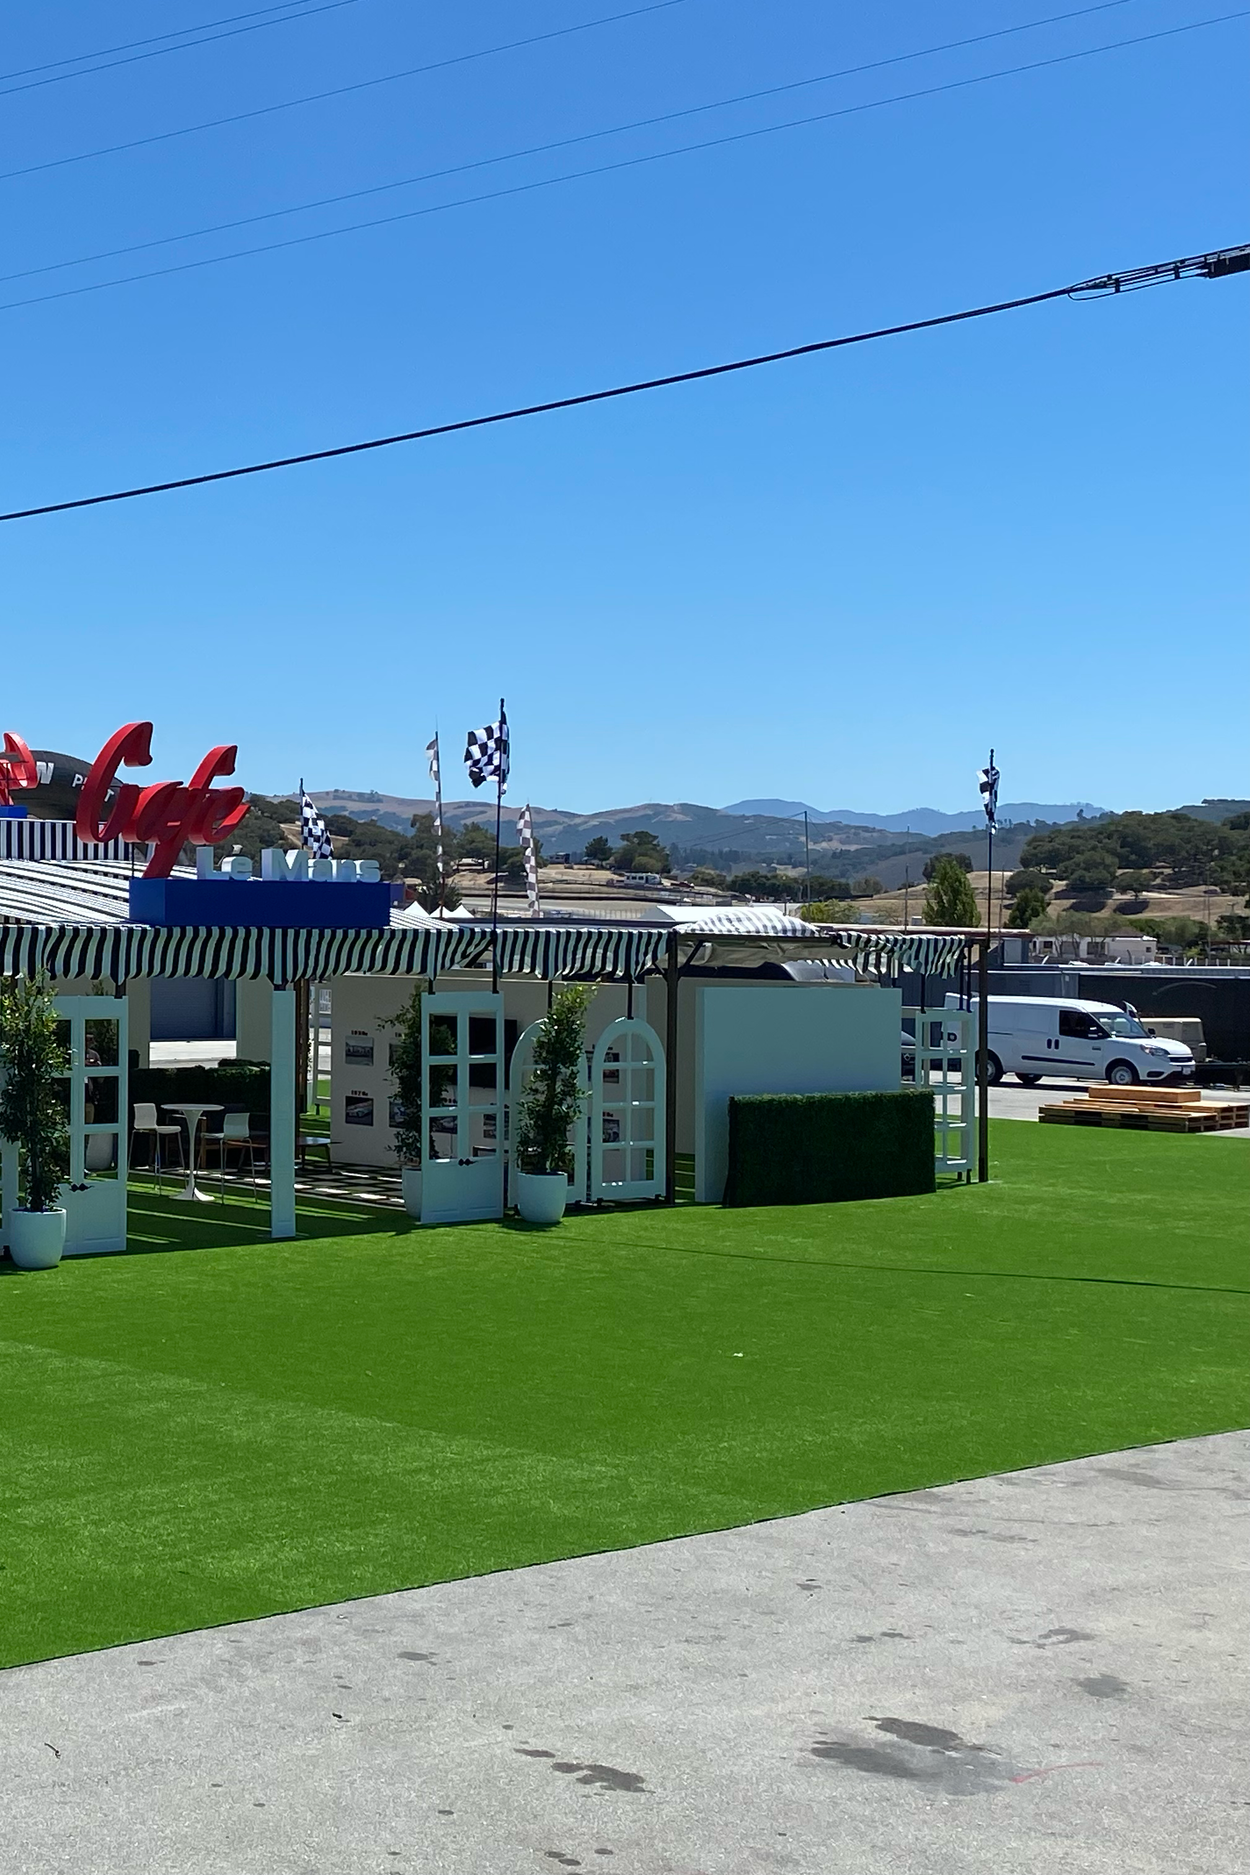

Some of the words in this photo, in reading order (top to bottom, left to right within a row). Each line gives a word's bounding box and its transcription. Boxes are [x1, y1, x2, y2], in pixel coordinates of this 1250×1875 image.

[76, 721, 250, 878] Cafe
[196, 846, 252, 880] Le
[261, 848, 381, 883] Mans
